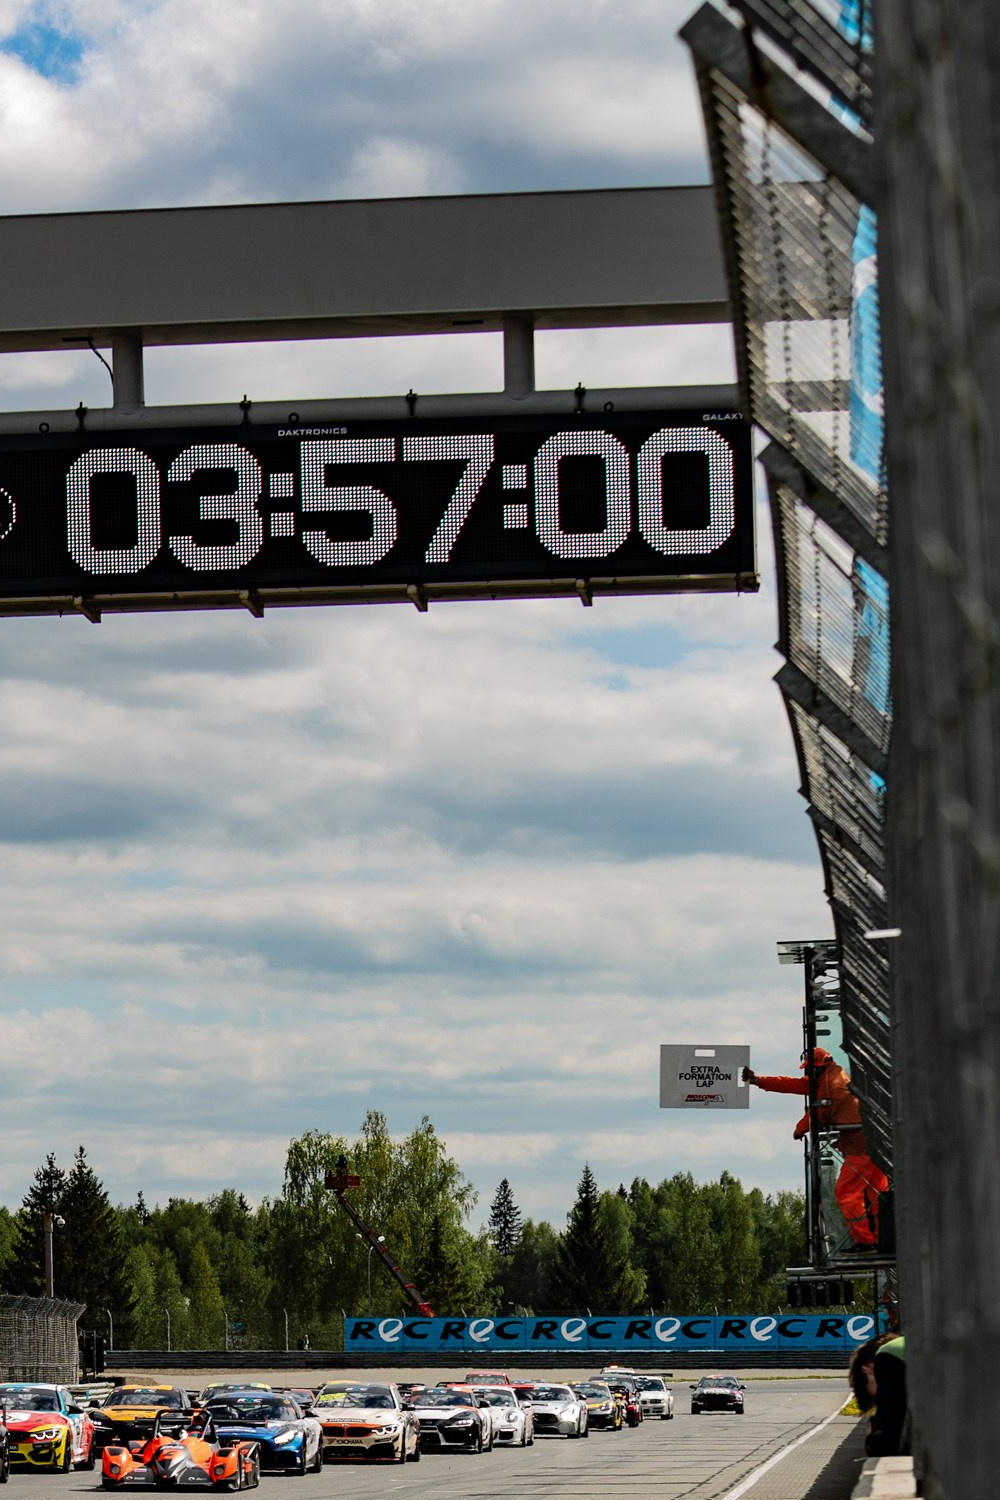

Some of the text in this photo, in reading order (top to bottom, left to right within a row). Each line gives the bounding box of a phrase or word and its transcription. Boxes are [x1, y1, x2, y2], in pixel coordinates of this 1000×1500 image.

[702, 413, 744, 421] GALAXY
[277, 427, 348, 437] DAKTRONICS
[66, 427, 735, 575] 03:57:00
